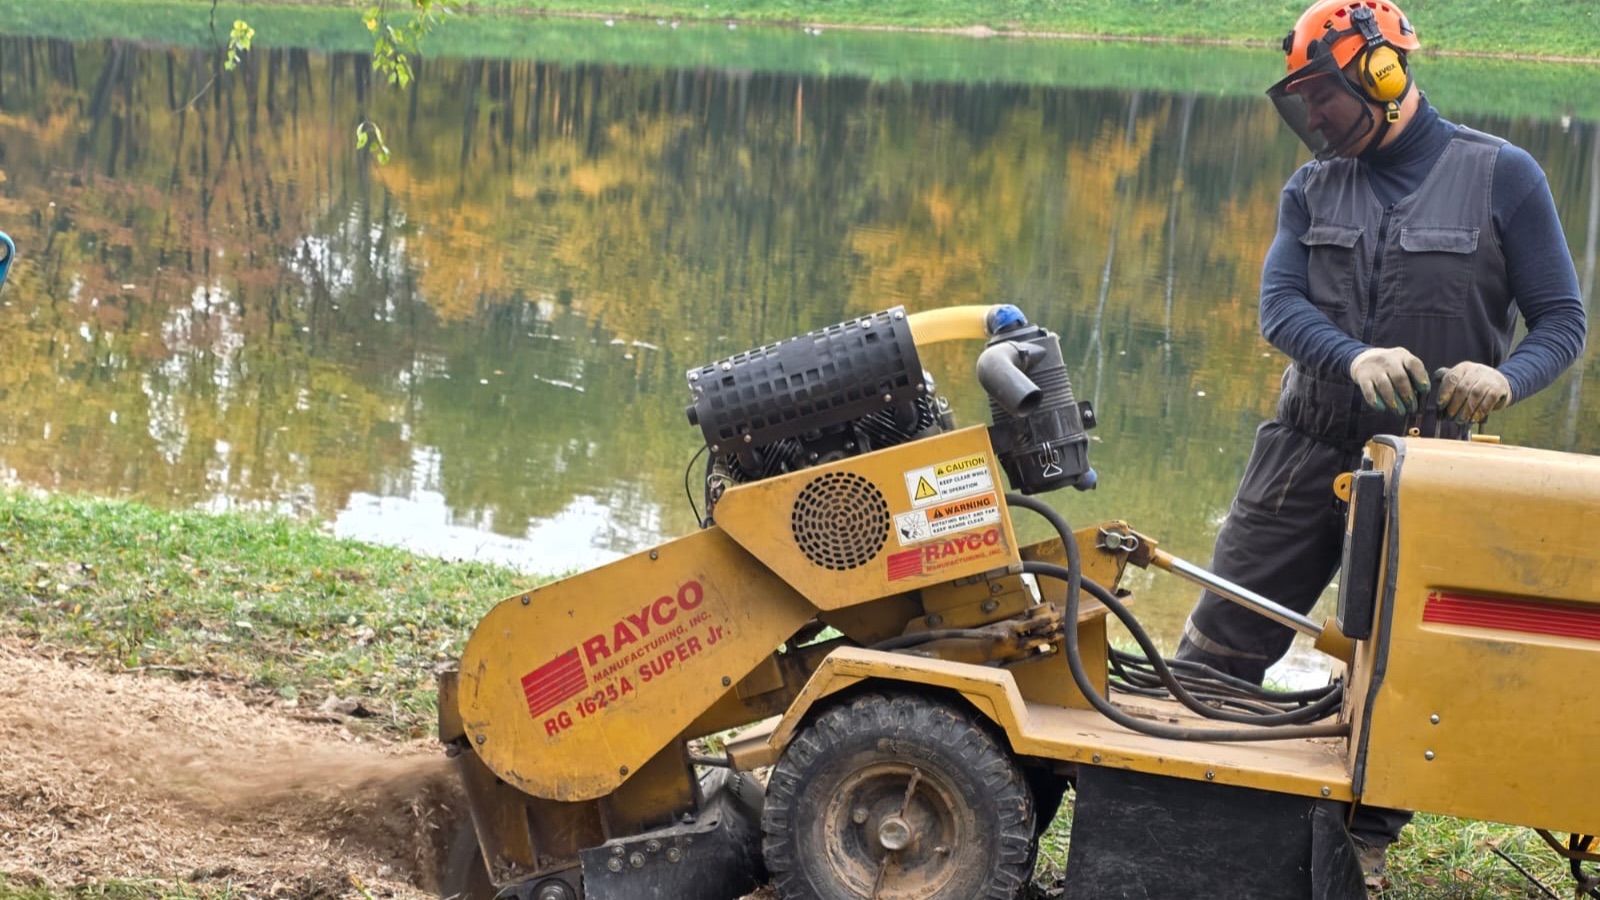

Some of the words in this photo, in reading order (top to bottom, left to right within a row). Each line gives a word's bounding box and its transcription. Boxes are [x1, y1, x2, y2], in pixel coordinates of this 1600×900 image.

[1375, 64, 1396, 78] uvex
[945, 457, 985, 473] CAUTION
[939, 478, 953, 486] KEEP
[954, 474, 971, 482] CLEAR
[972, 469, 988, 477] WHILE
[949, 482, 978, 494] OPERATION
[944, 497, 991, 516] WARNING
[933, 526, 947, 534] KEEP
[948, 521, 966, 530] HANDS
[967, 517, 984, 525] CLEAR
[925, 528, 1000, 561] RAYCO
[582, 580, 704, 668] RAYCO
[592, 624, 688, 683] MANUFACTURING,
[689, 611, 712, 628] INC.
[543, 711, 574, 737] RG
[638, 636, 702, 683] SUPER
